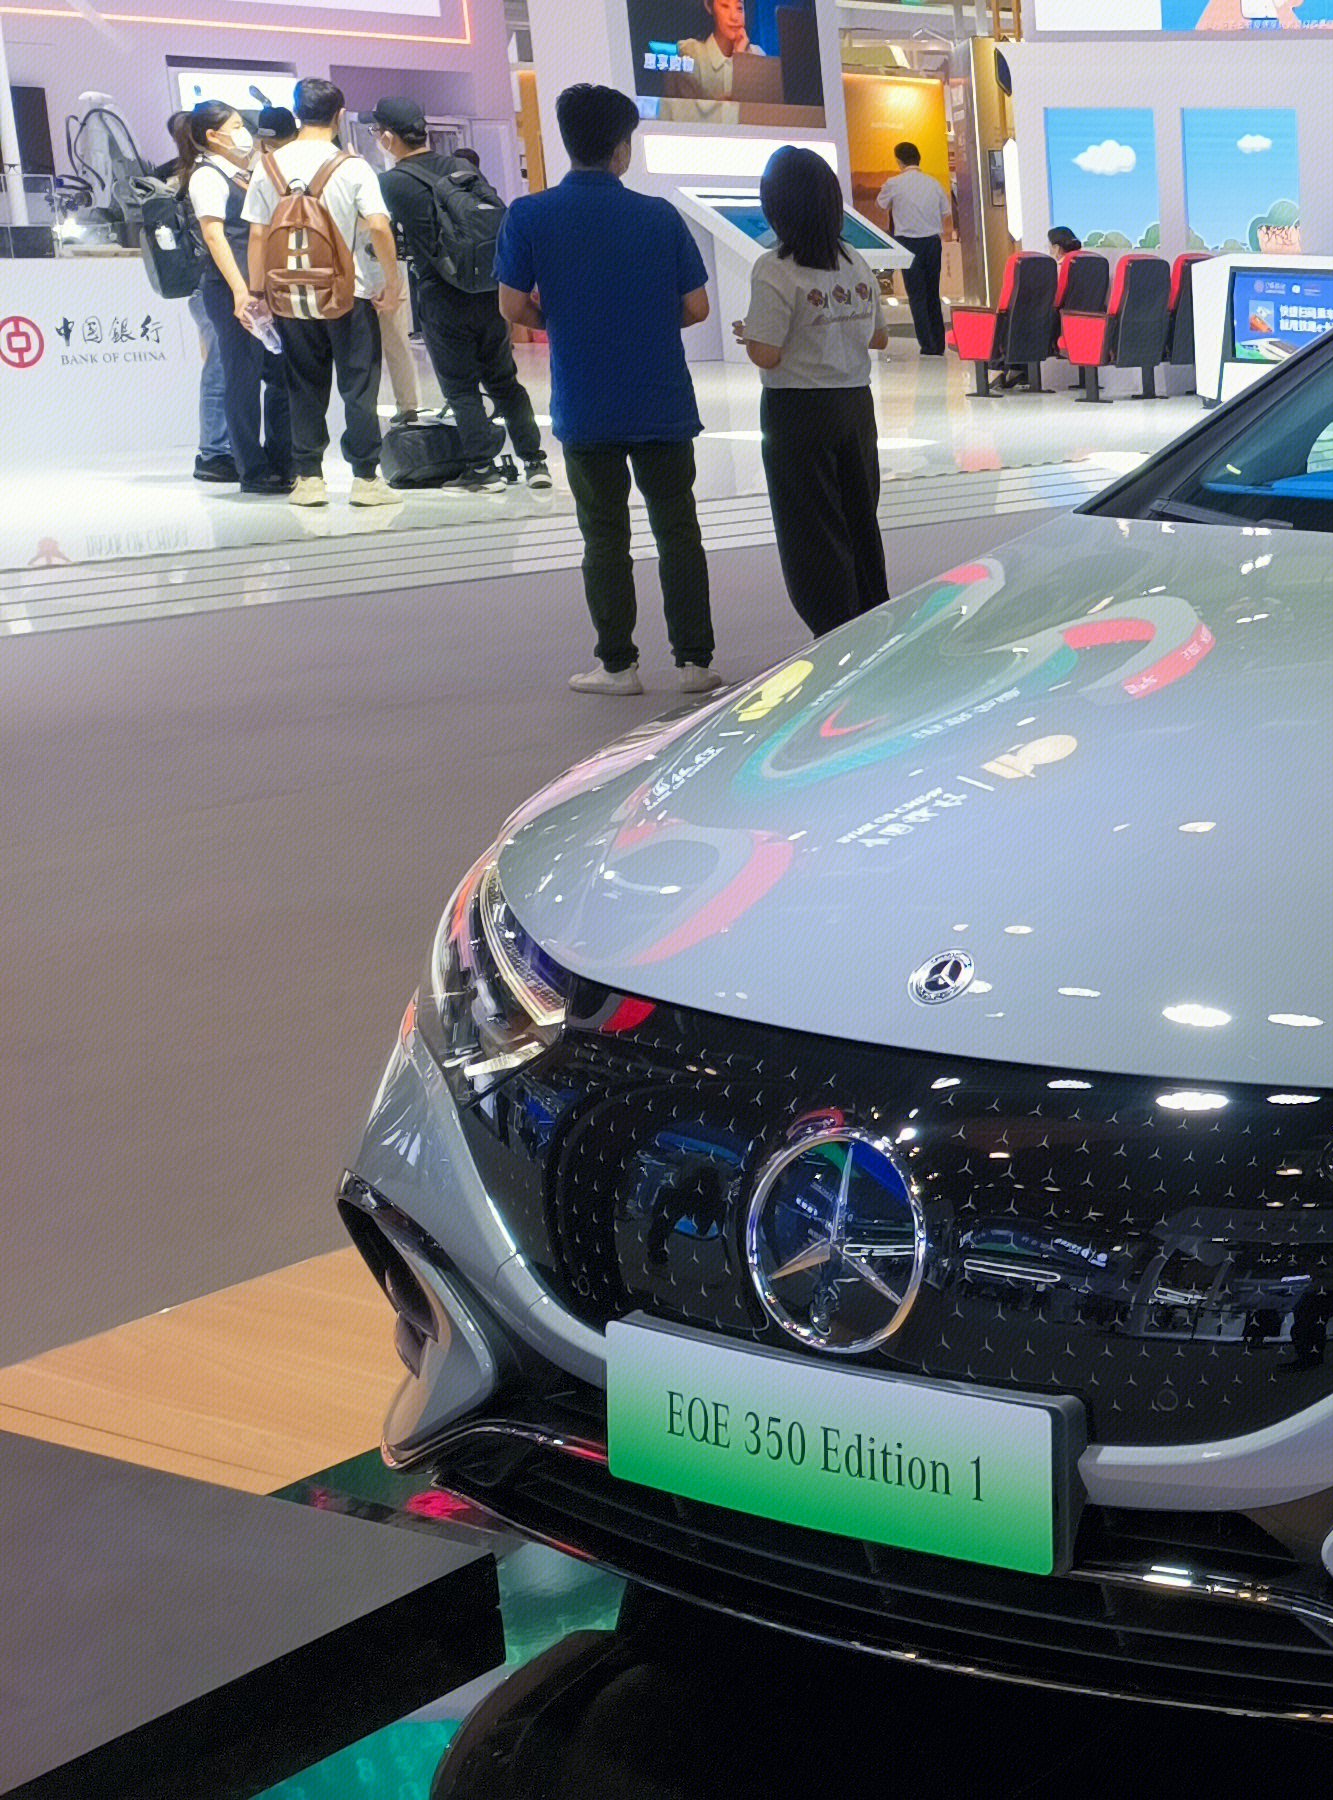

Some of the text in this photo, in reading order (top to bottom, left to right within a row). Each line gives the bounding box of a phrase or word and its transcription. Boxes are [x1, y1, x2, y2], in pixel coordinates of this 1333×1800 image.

[61, 351, 167, 366] BANK OF CHINA
[666, 1390, 985, 1502] EQE 350 Edition 1
